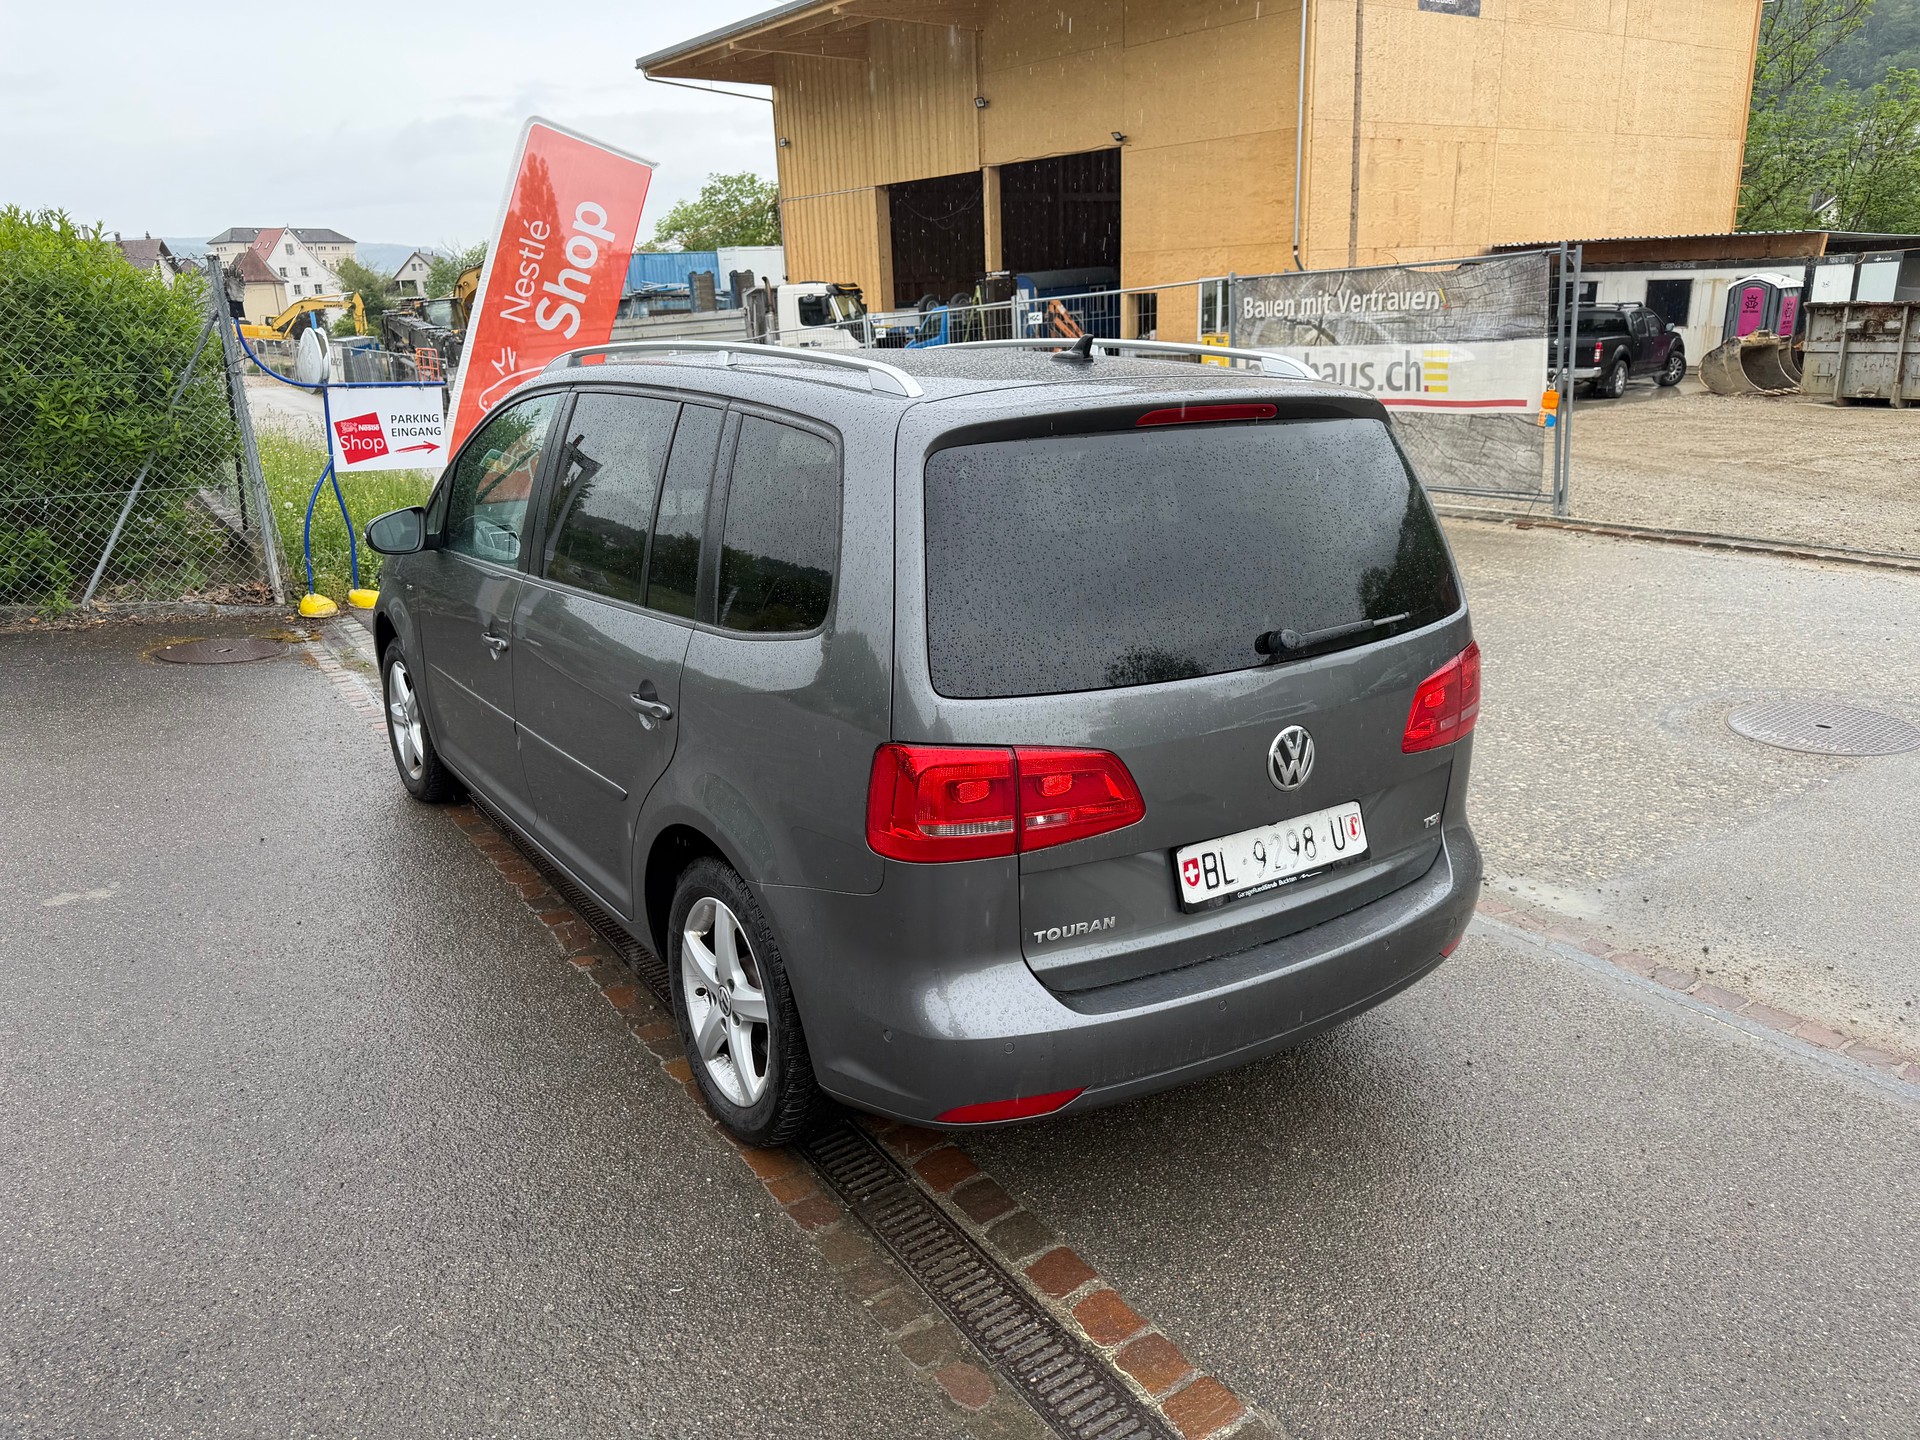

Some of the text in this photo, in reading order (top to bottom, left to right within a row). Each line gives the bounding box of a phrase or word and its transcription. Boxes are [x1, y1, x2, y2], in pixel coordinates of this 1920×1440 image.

[500, 219, 550, 323] Nestlé
[535, 201, 615, 340] Shop
[1243, 297, 1295, 319] Bauen
[1300, 290, 1329, 315] mit
[391, 414, 440, 424] PARKING
[391, 427, 442, 437] EINGANG
[340, 435, 385, 453] Shop
[1202, 815, 1346, 890] BL 9298 U
[1033, 916, 1116, 944] TOURAN
